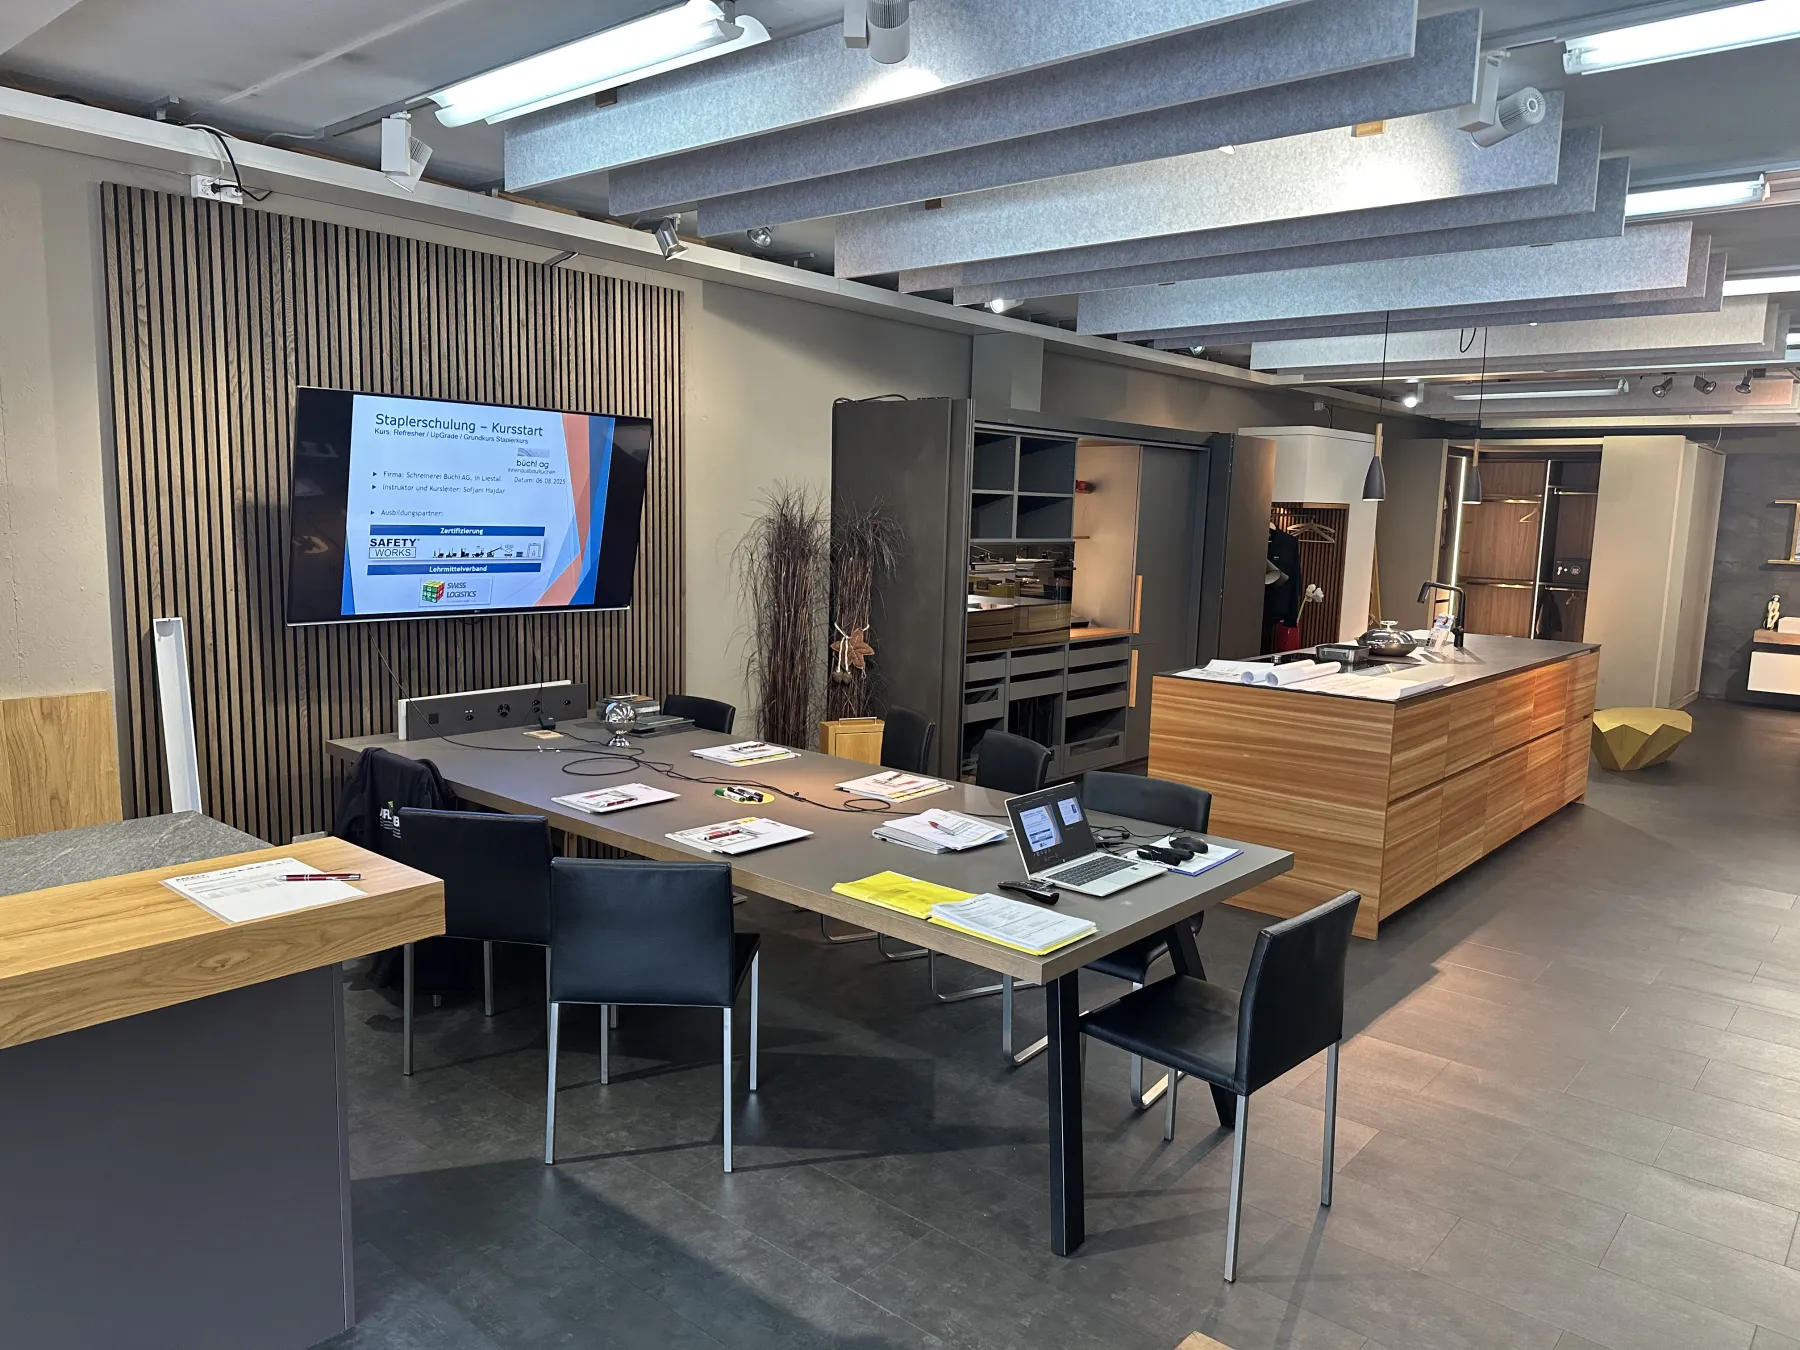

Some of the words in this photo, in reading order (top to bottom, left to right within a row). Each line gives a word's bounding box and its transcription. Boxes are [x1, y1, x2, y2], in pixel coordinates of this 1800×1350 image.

[375, 413, 476, 434] Staplerschulung
[491, 422, 544, 437] Kursstart
[393, 428, 425, 438] Refresher
[430, 431, 459, 440] UpGrade
[463, 433, 495, 442] Grundkurs
[538, 461, 549, 470] ag
[383, 470, 404, 479] Firma:
[406, 471, 442, 480] Schreinerei
[382, 483, 414, 492] Instruktor
[429, 485, 462, 493] Kursleiter:
[380, 509, 443, 518] Ausbildungspartner:
[440, 527, 484, 536] Zertifizierung
[369, 538, 417, 547] SAFETY
[375, 548, 412, 557] WORKS
[429, 565, 488, 573] Lehrmittelverband
[446, 581, 467, 589] SWISS
[446, 590, 477, 599] LOGISTICS
